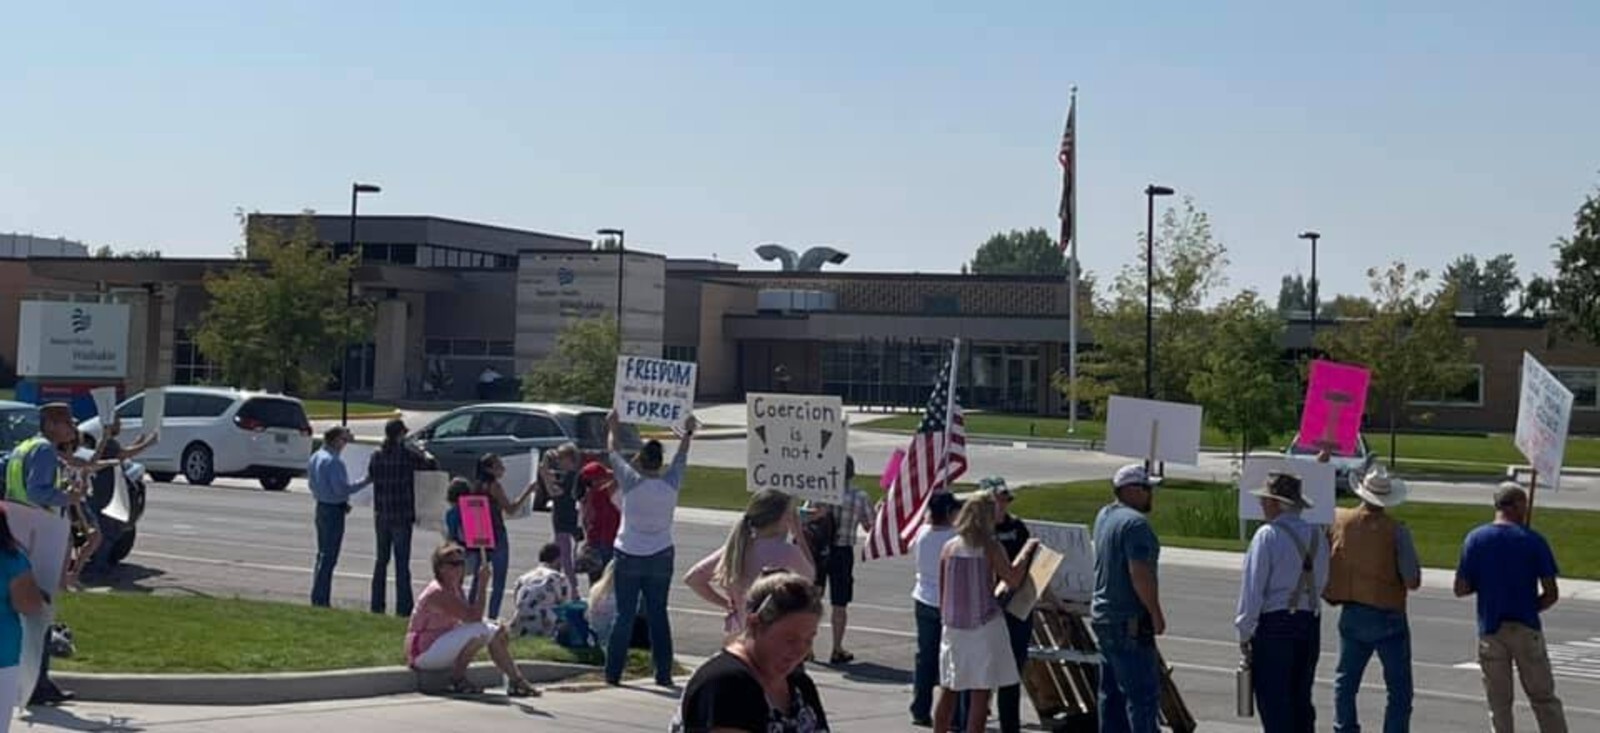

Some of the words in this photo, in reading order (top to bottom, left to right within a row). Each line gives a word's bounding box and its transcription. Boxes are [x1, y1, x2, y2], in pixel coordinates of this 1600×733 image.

[626, 357, 692, 387] FREEDOM
[626, 400, 681, 420] FORCE
[754, 397, 835, 422] Coercion
[790, 427, 802, 442] is
[781, 444, 810, 460] not
[753, 464, 840, 490] Consent
